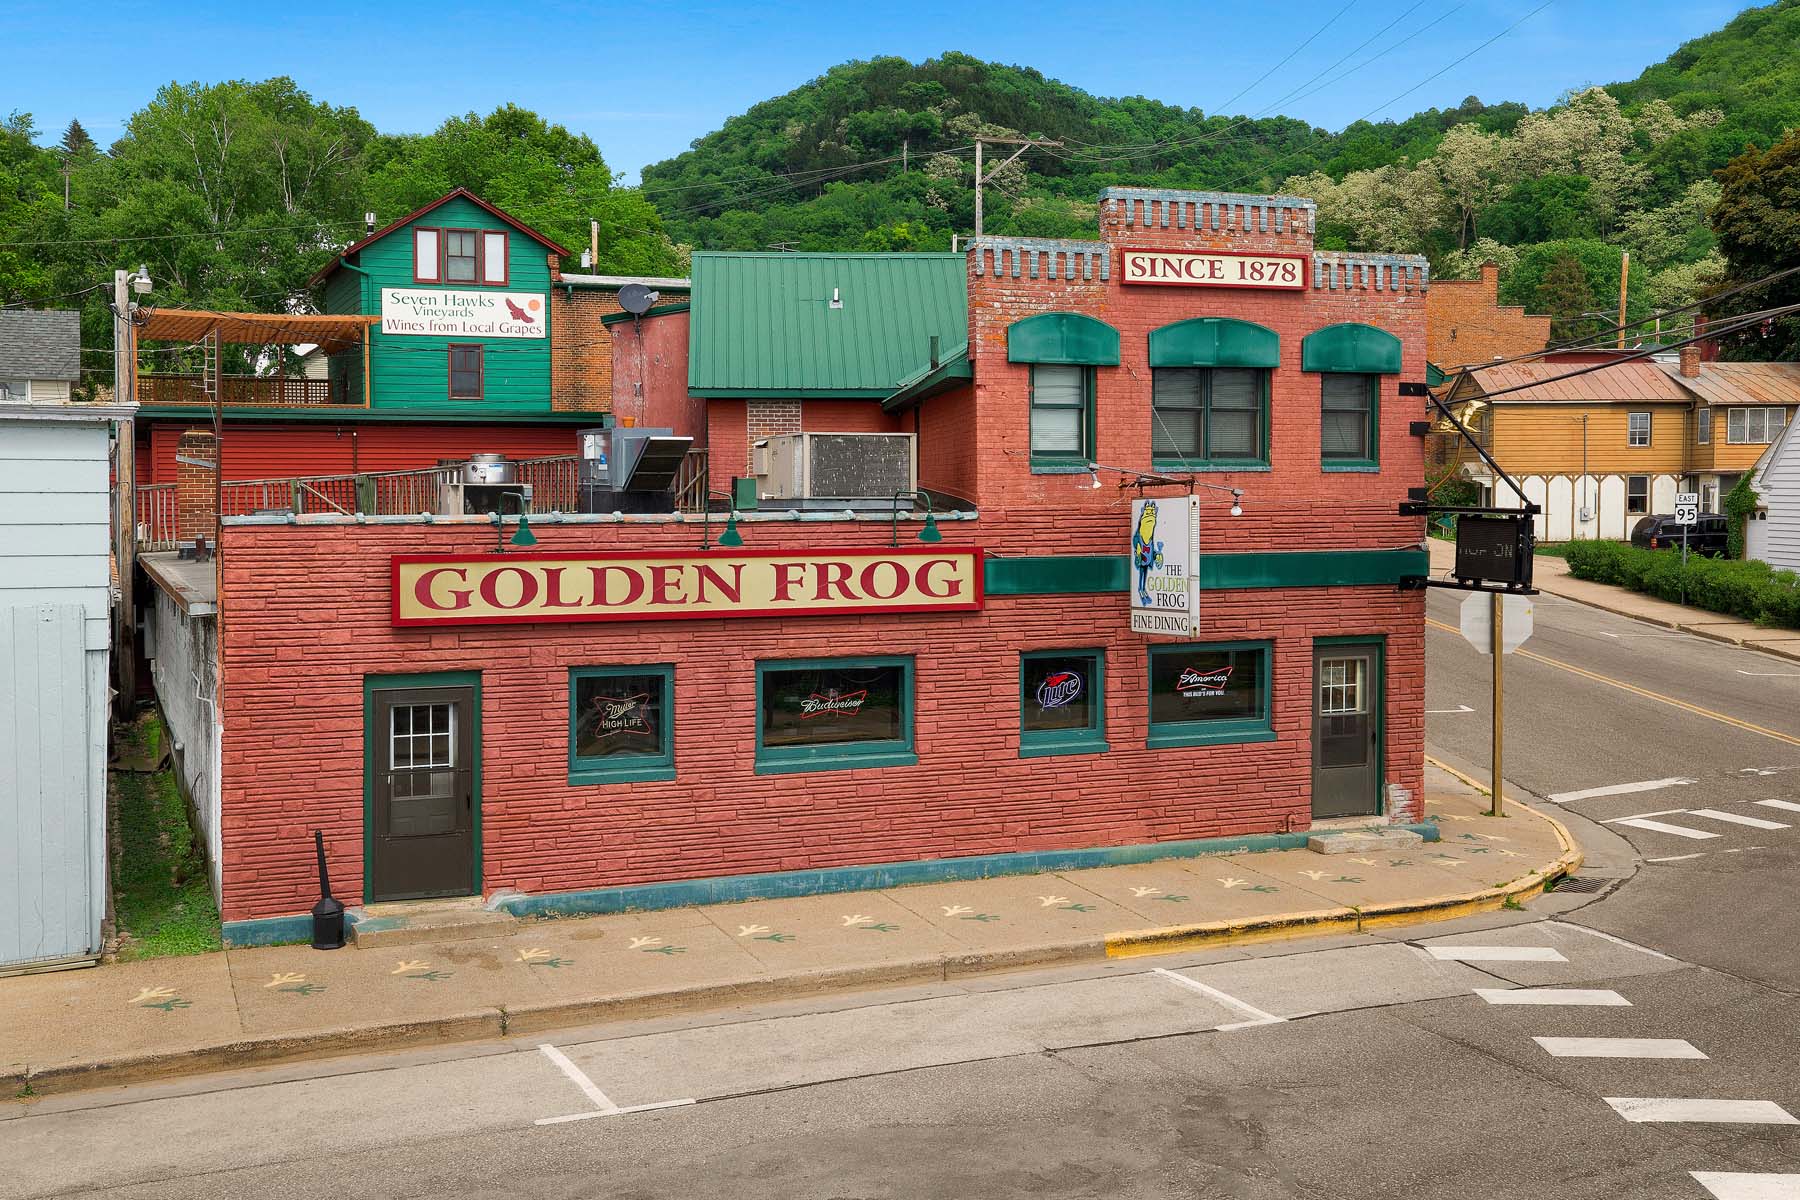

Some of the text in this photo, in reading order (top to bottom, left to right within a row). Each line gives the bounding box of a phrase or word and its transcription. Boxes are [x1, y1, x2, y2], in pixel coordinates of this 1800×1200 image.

[1131, 256, 1297, 283] SINCE 1878
[390, 291, 495, 308] Seven Hawks
[412, 305, 474, 320] Vineyards
[386, 317, 542, 337] Wines from Local Grapes
[1677, 508, 1695, 521] 95
[1164, 564, 1182, 576] THE
[413, 559, 964, 611] GOLDEN FROG
[1147, 576, 1189, 593] GOLDEN
[1157, 592, 1185, 608] FROG
[1133, 614, 1188, 632] FINE DINING
[1043, 678, 1078, 708] Lite
[605, 701, 637, 716] Miller
[800, 698, 865, 713] Budweiser
[602, 718, 643, 729] HIGH LIFE
